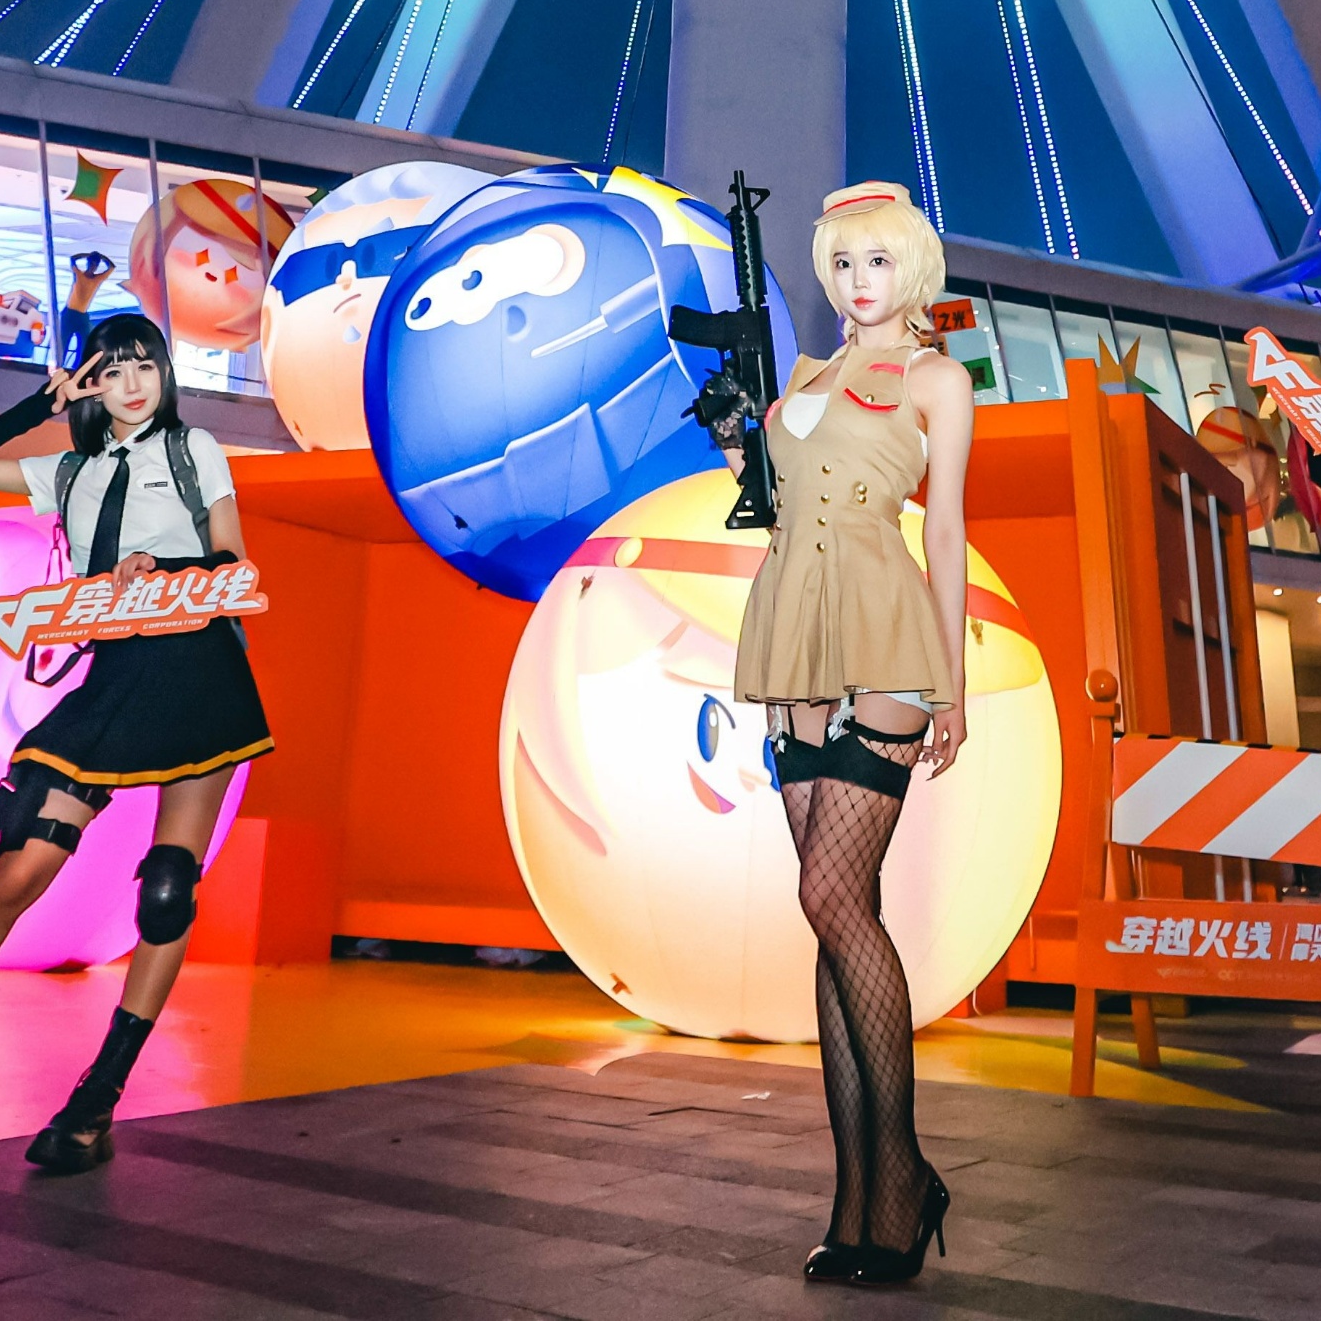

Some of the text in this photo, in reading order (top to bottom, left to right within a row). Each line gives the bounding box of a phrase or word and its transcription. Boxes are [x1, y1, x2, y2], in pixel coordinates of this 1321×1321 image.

[61, 566, 262, 626] 穿越火线
[142, 618, 204, 630] CORPORATION
[1105, 916, 1272, 960] 穿越火线
